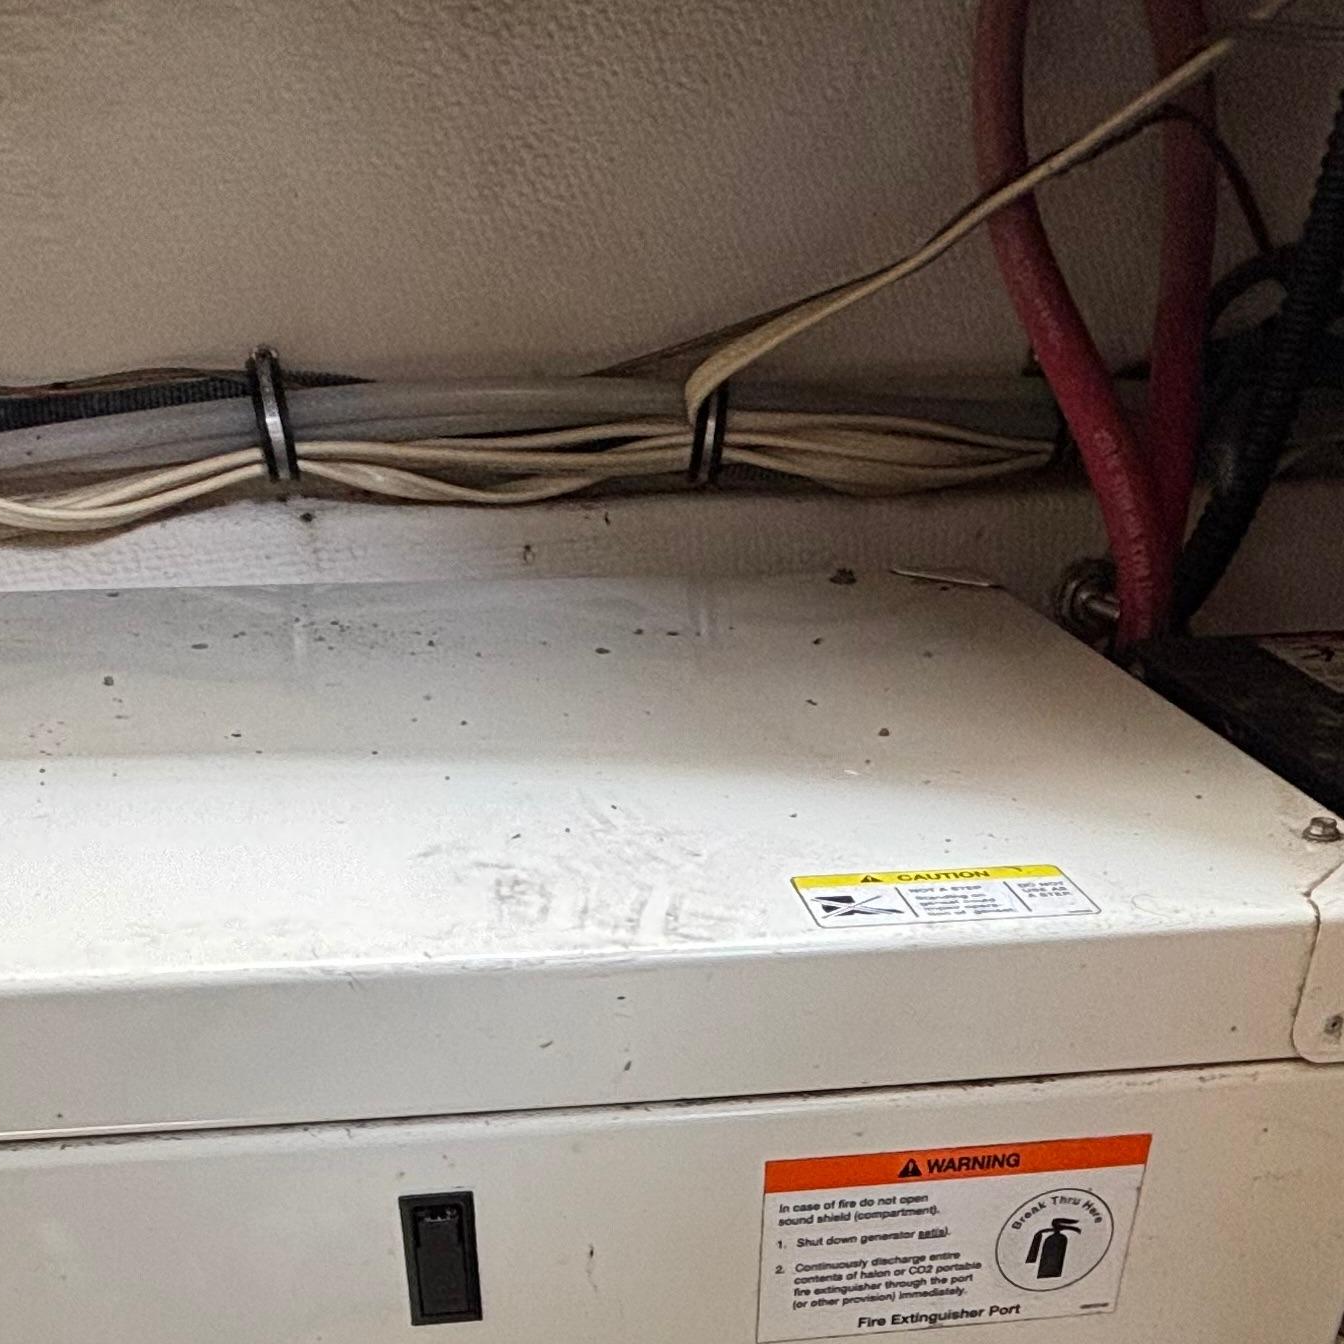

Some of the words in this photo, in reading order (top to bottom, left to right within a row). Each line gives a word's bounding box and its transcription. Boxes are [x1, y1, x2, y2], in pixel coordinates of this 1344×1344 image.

[897, 870, 991, 882] CAUTION
[927, 1153, 1021, 1174] WARNING
[779, 1204, 790, 1214] In
[793, 1203, 821, 1214] case
[824, 1199, 835, 1210] of
[838, 1199, 856, 1209] fire
[859, 1196, 875, 1207] do
[878, 1196, 896, 1206] not
[900, 1194, 929, 1206] open
[1011, 1201, 1047, 1230] Break
[1050, 1196, 1081, 1206] Thru
[1082, 1200, 1103, 1224] Here
[778, 1212, 814, 1226] sound
[817, 1210, 851, 1224] shield
[854, 1205, 940, 1223] (compartment).
[797, 1237, 824, 1248] Shut
[826, 1234, 857, 1246] down
[860, 1231, 916, 1245] generator
[795, 1257, 868, 1273] Continuously
[871, 1254, 926, 1267] discharge
[929, 1251, 960, 1261] entire
[794, 1273, 843, 1286] contents
[846, 1271, 858, 1281] of
[860, 1269, 891, 1280] halon
[894, 1268, 906, 1277] or
[909, 1265, 932, 1276] CO2
[936, 1261, 982, 1274] portable
[794, 1287, 811, 1297] fire
[813, 1281, 881, 1296] extinguisher
[885, 1278, 927, 1291] through
[930, 1276, 948, 1285] the
[950, 1274, 973, 1285] port
[792, 1299, 808, 1310] (or
[810, 1298, 839, 1309] other
[842, 1292, 896, 1307] provision)
[899, 1286, 966, 1301] immediately.
[858, 1317, 886, 1329] Fire
[891, 1308, 985, 1326] Extinguisher
[989, 1304, 1021, 1317] Port
